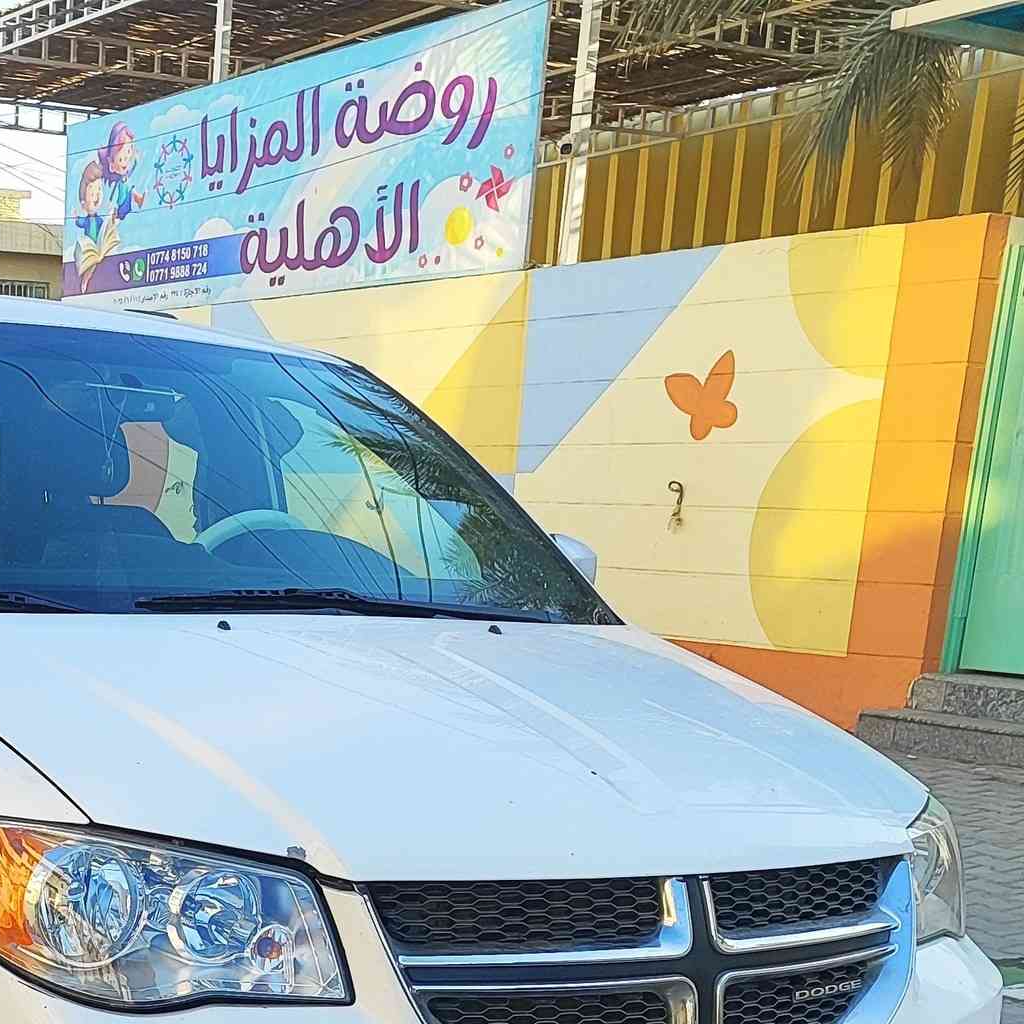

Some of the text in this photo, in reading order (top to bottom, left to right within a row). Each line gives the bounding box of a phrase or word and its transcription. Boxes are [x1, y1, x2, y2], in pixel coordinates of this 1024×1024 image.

[199, 62, 498, 195] روضة المزايا
[150, 244, 209, 265] 0774 8150 718
[149, 267, 169, 282] 0771
[192, 262, 208, 276] 724
[795, 979, 863, 1001] DODGE
